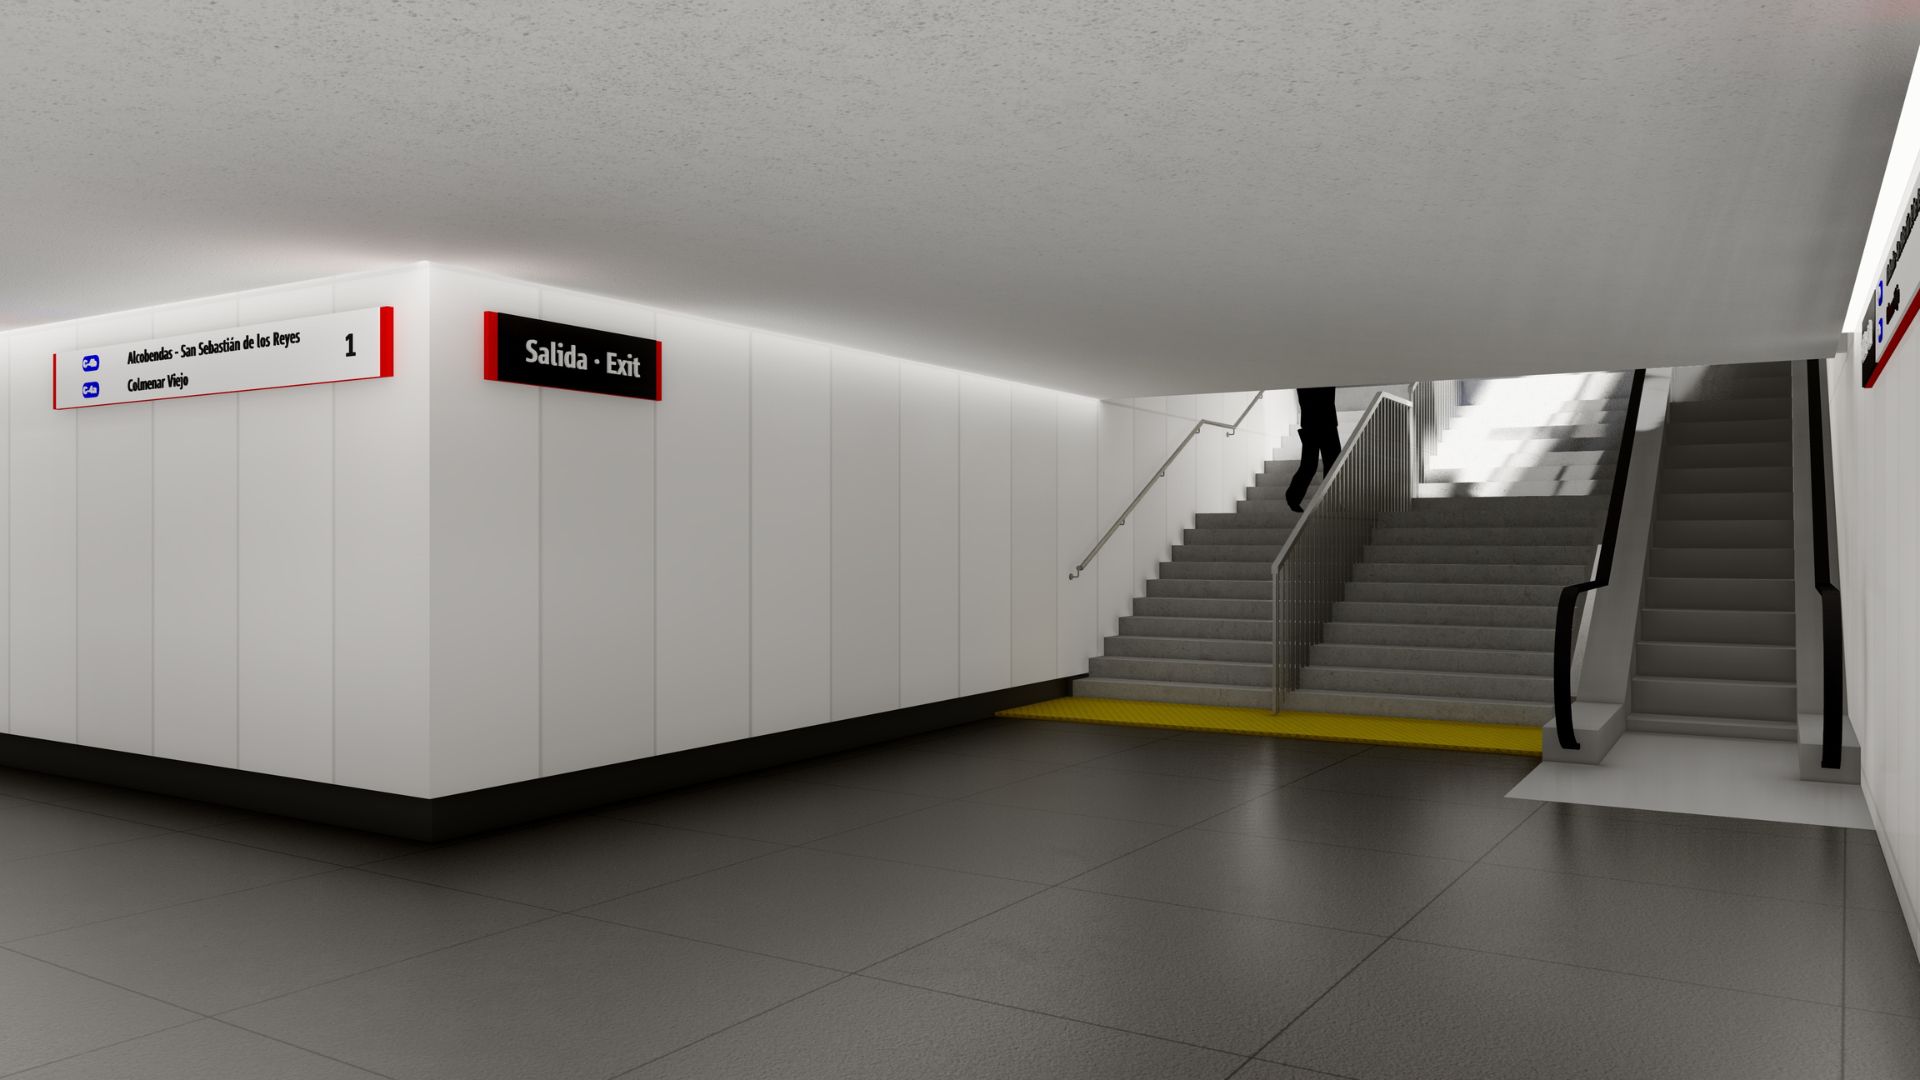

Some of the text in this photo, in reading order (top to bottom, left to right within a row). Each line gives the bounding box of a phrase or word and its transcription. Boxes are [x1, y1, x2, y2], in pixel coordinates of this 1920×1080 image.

[127, 346, 174, 365] Alcobendas
[180, 344, 197, 359] San
[198, 336, 241, 356] Sebastián
[242, 334, 255, 350] de
[256, 333, 271, 349] los
[272, 331, 301, 349] Reyes
[345, 333, 357, 358] 1
[525, 339, 588, 371] Salida
[606, 351, 641, 378] Exit
[127, 372, 189, 393] Colmenar Viejo
